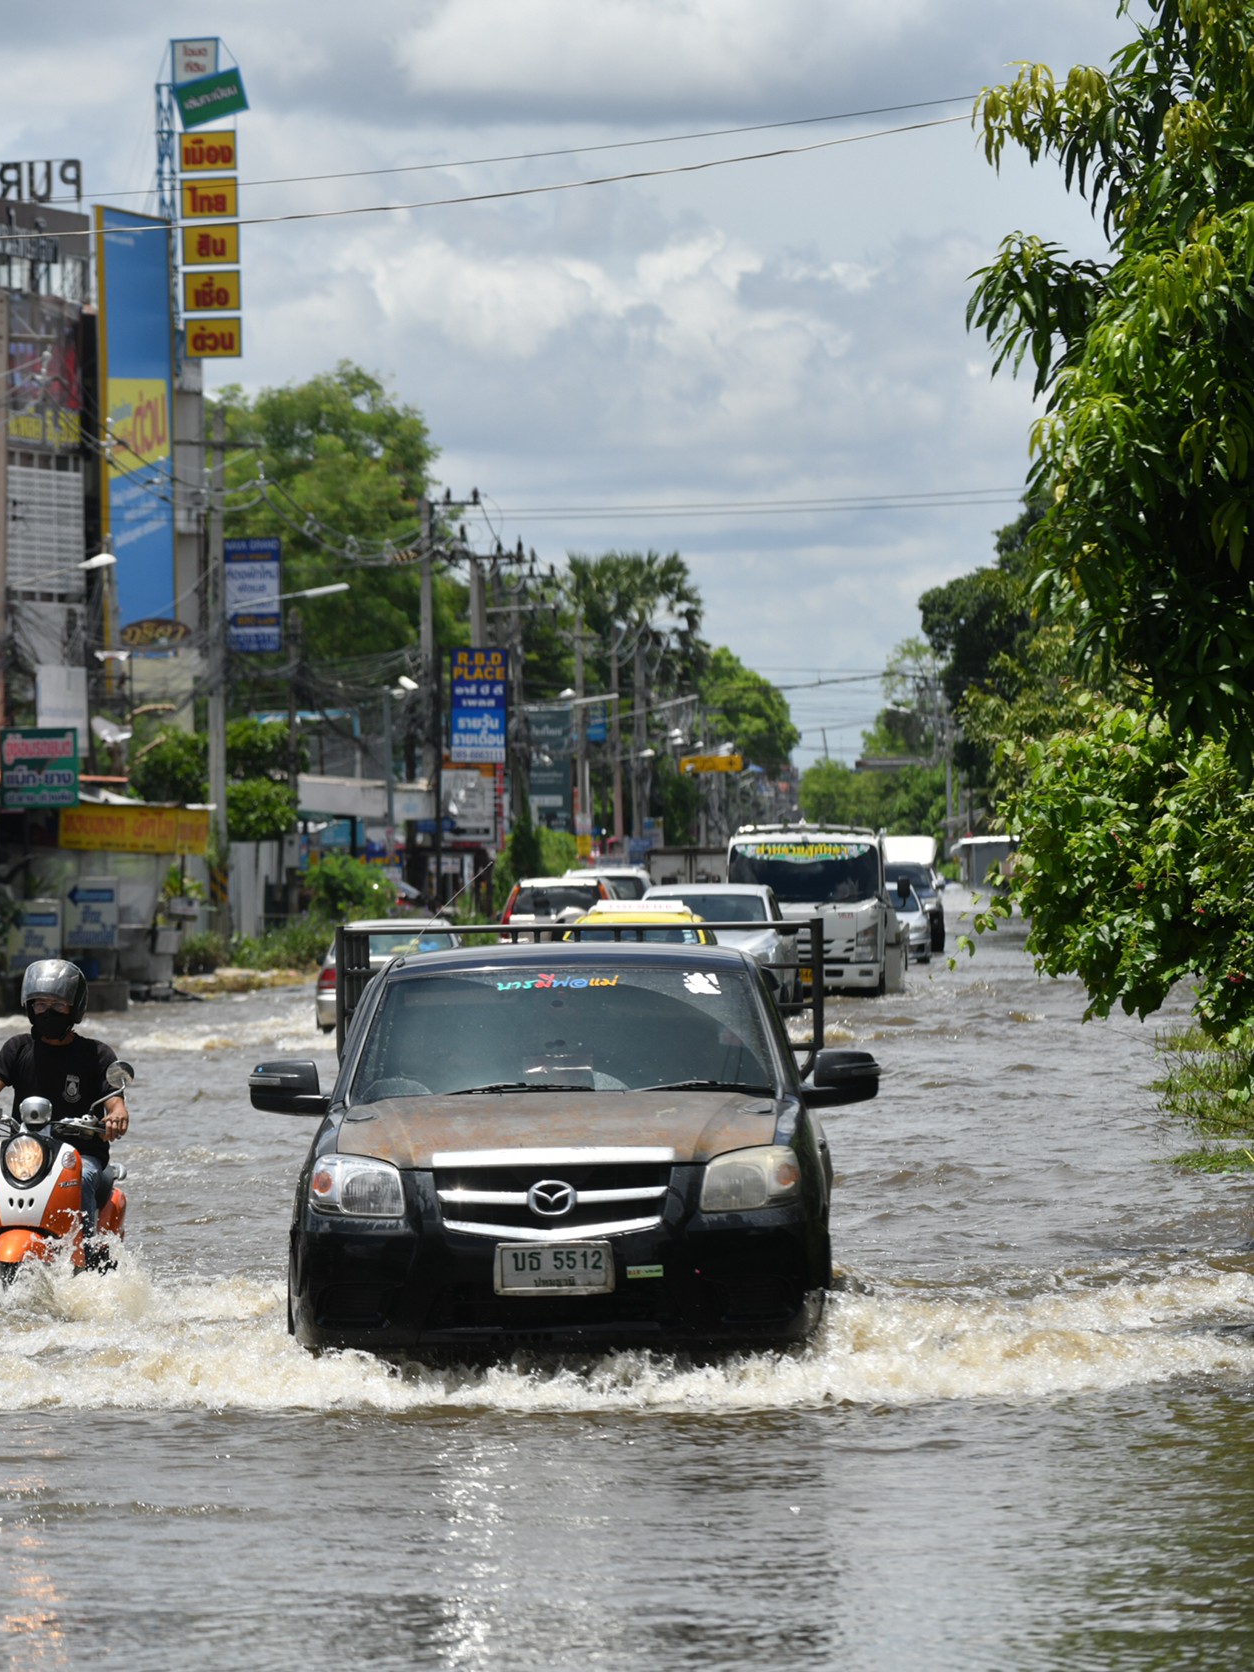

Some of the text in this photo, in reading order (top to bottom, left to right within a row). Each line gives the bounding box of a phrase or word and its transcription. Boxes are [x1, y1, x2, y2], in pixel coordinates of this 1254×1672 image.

[183, 138, 233, 166] เมือง
[187, 186, 227, 213] ไทย
[197, 233, 226, 257] สิน
[193, 276, 230, 307] เชื่อ
[192, 325, 234, 351] ด่วน
[457, 652, 503, 666] R.B.D
[453, 666, 506, 681] PLACE
[457, 713, 500, 730] รายวัน
[453, 729, 505, 746] รายเดือน
[497, 973, 619, 991] บารมีพ่อแม่
[512, 1250, 604, 1272] บธ 5512
[533, 1274, 576, 1288] ปทุมธานี
